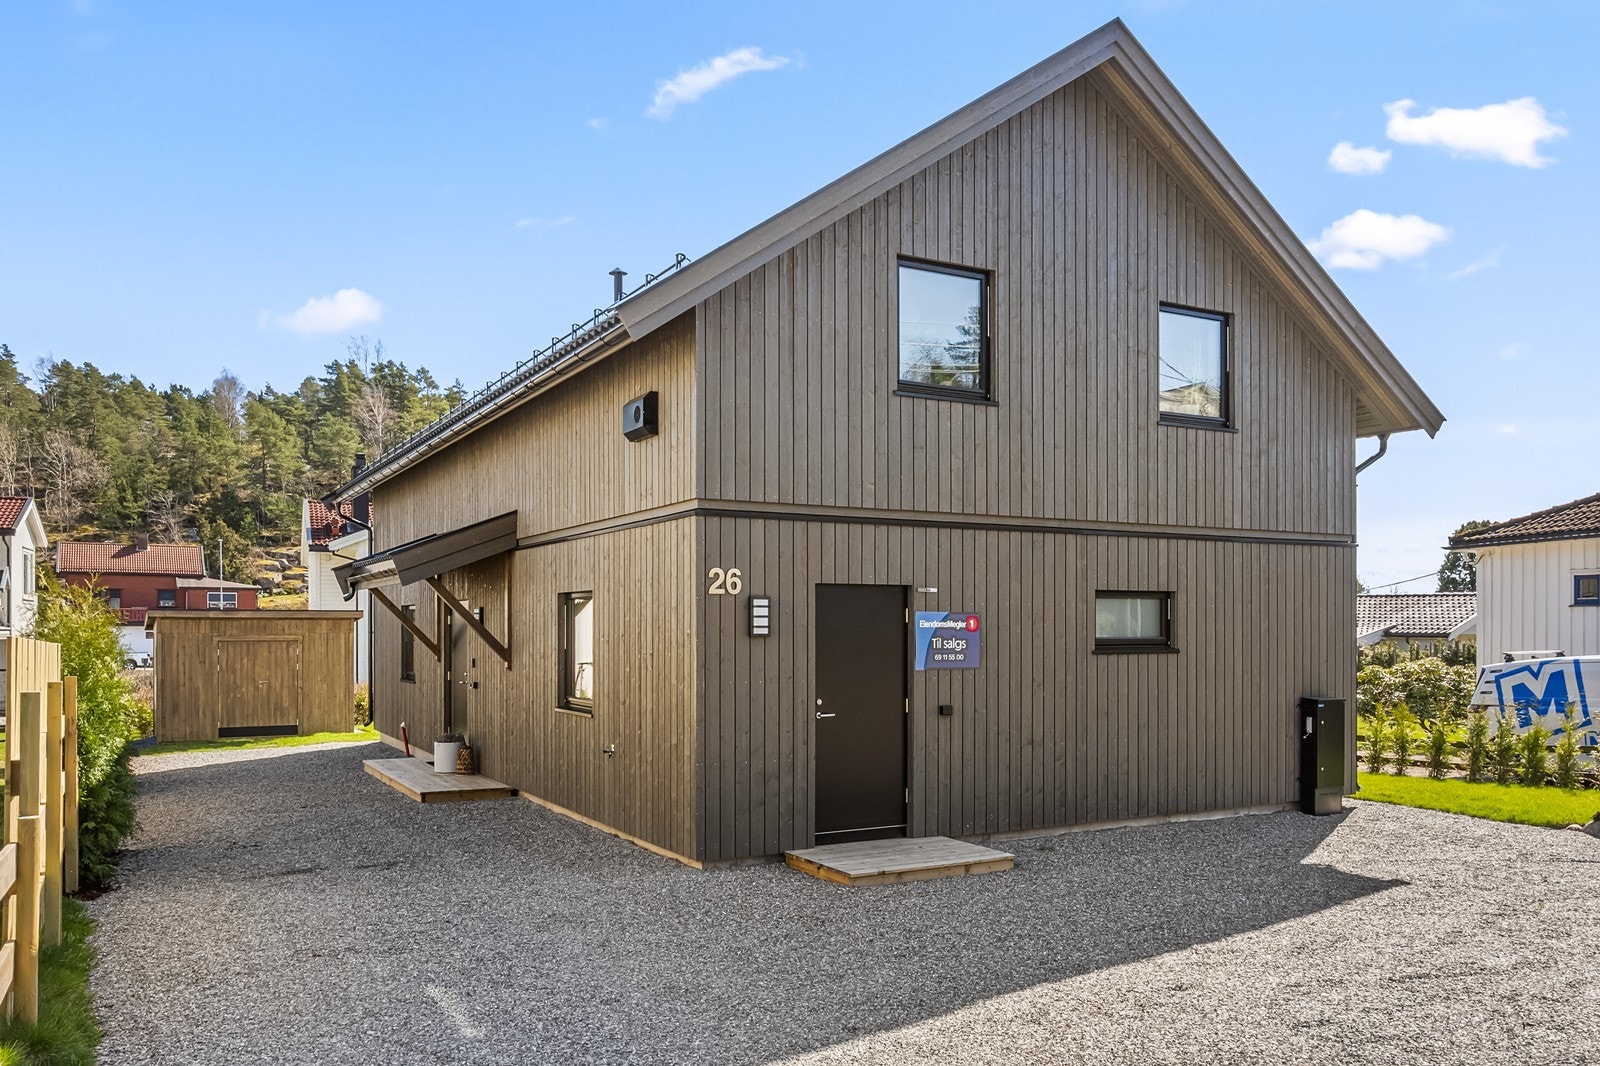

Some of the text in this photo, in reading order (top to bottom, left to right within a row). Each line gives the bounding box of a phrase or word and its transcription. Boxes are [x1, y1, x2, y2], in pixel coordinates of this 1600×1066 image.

[708, 567, 742, 595] 26
[919, 620, 967, 629] EiendomsMegler
[931, 637, 967, 651] Til salgs
